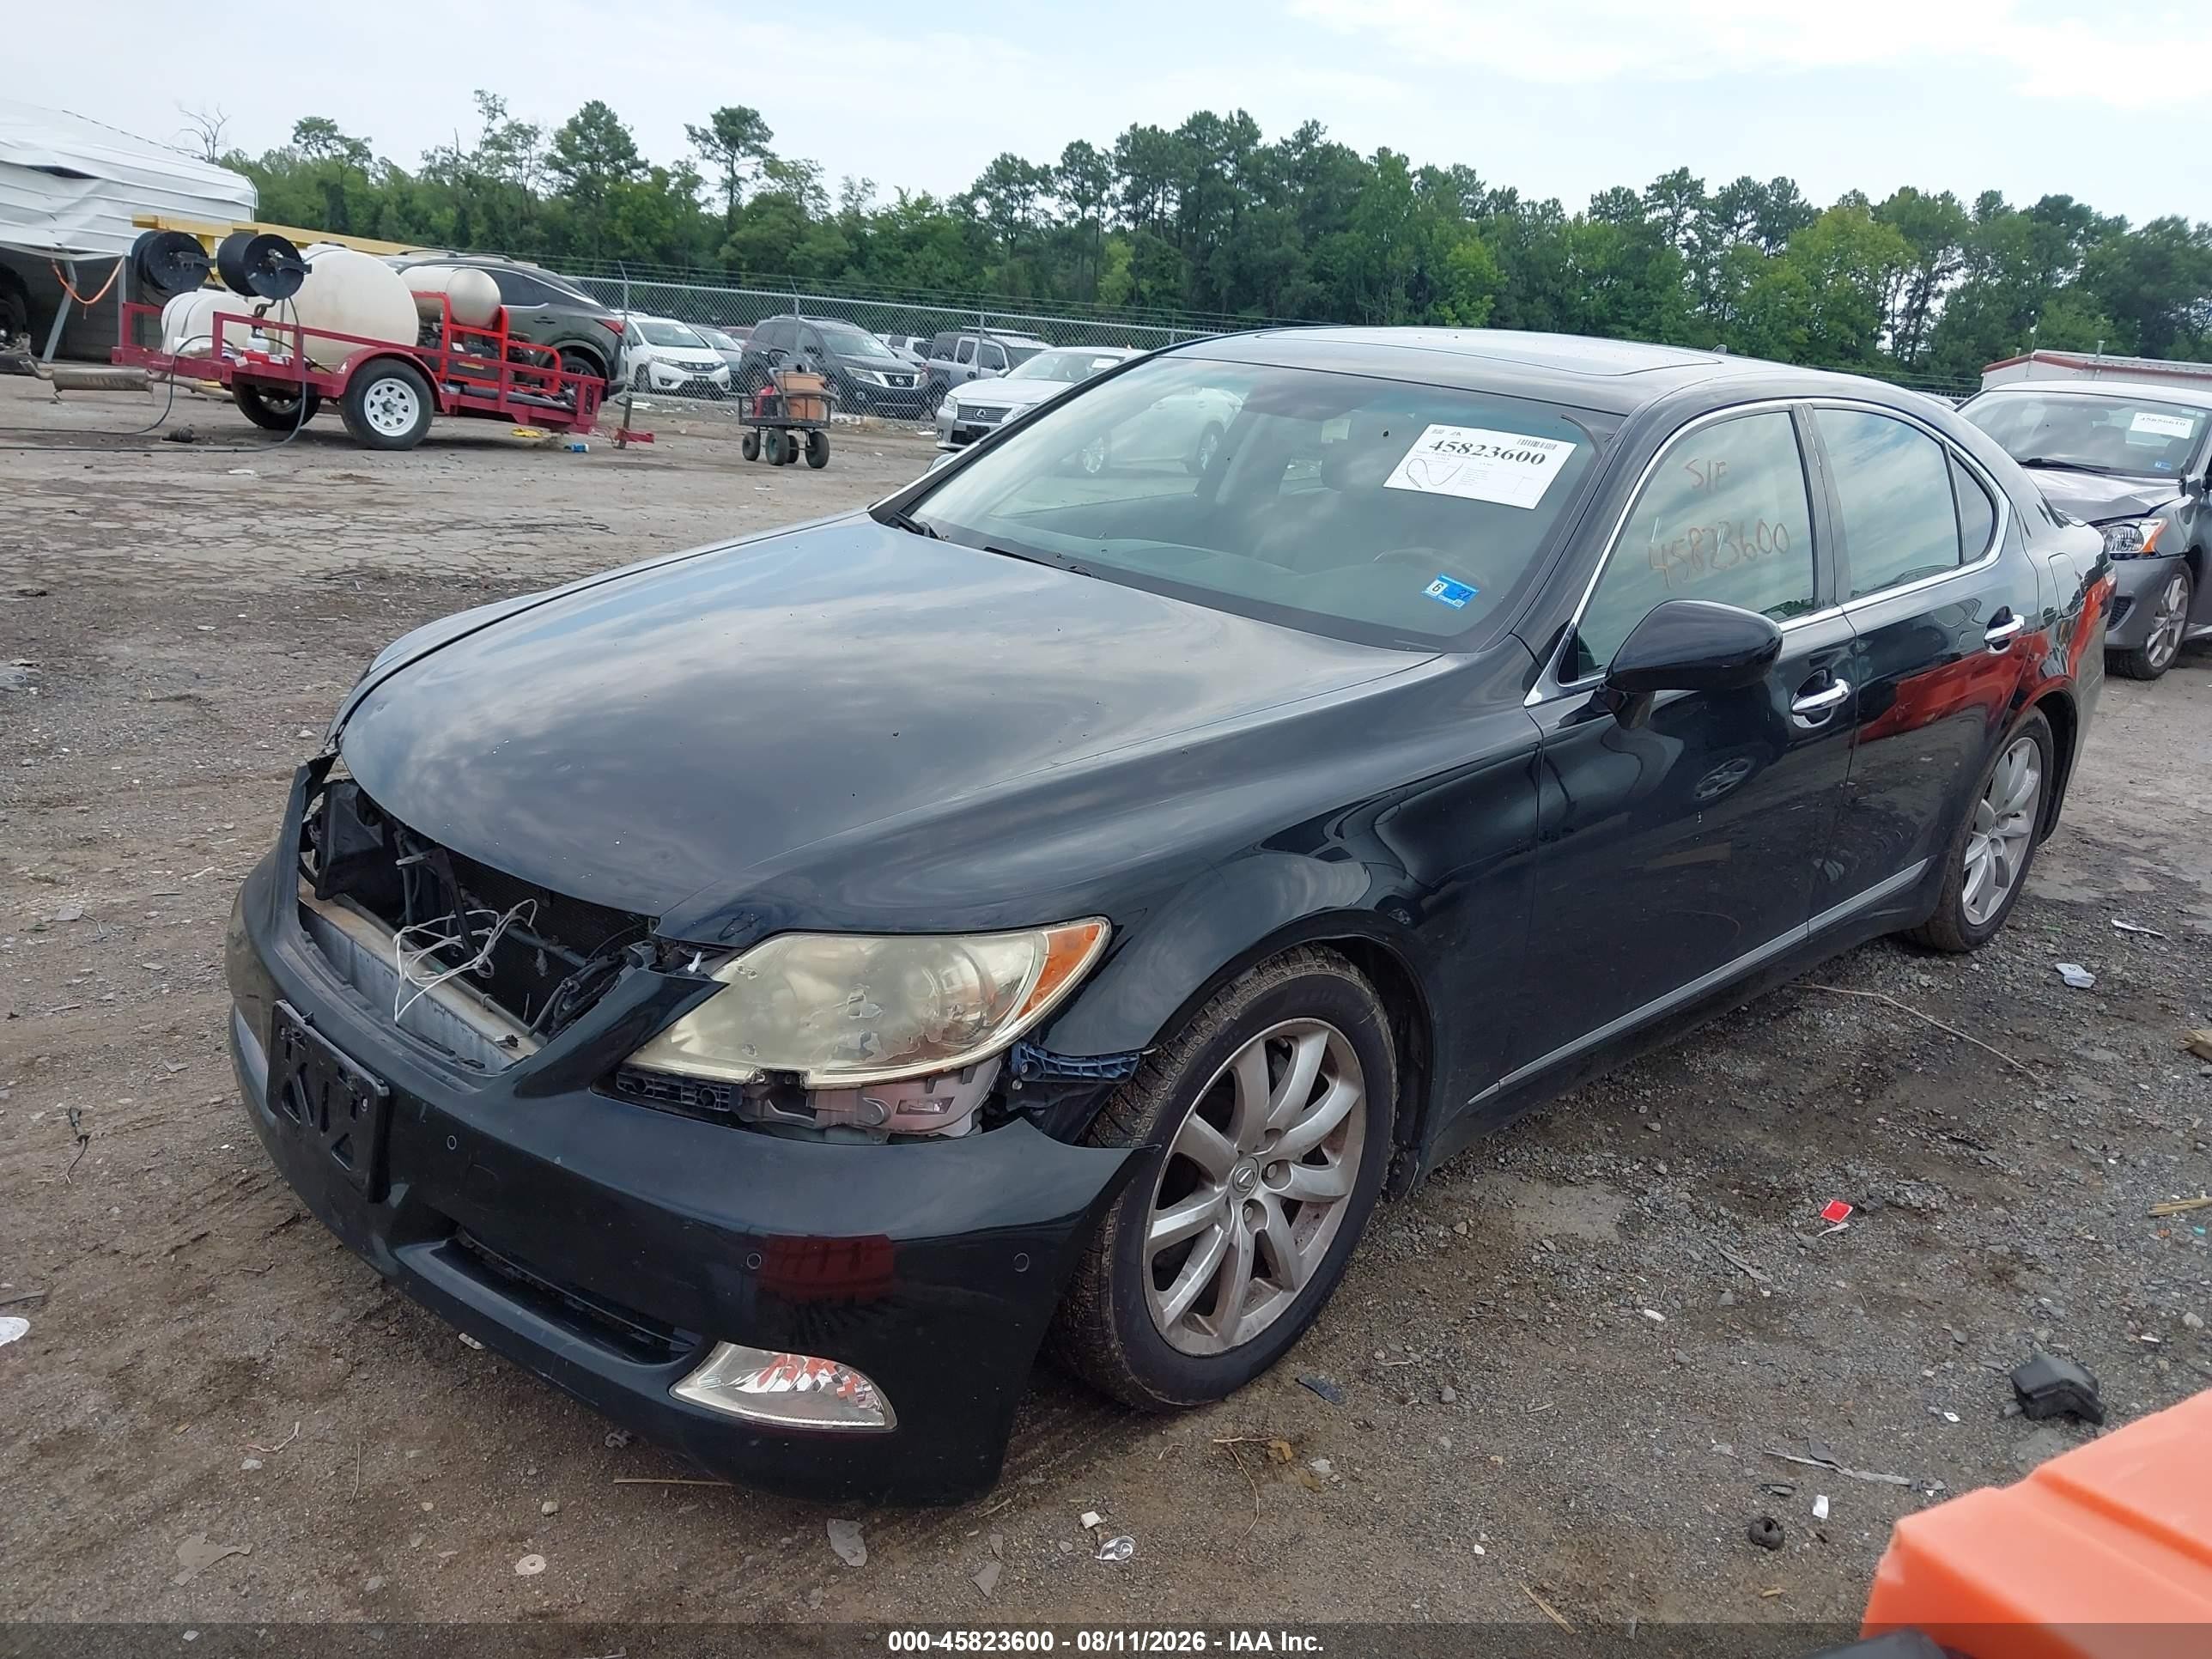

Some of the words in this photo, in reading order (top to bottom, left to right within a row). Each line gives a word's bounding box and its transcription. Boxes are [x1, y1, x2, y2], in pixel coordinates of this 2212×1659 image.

[1429, 440, 1546, 465] 45823600
[1648, 518, 1790, 589] 45823600
[1431, 583, 1444, 592] 6
